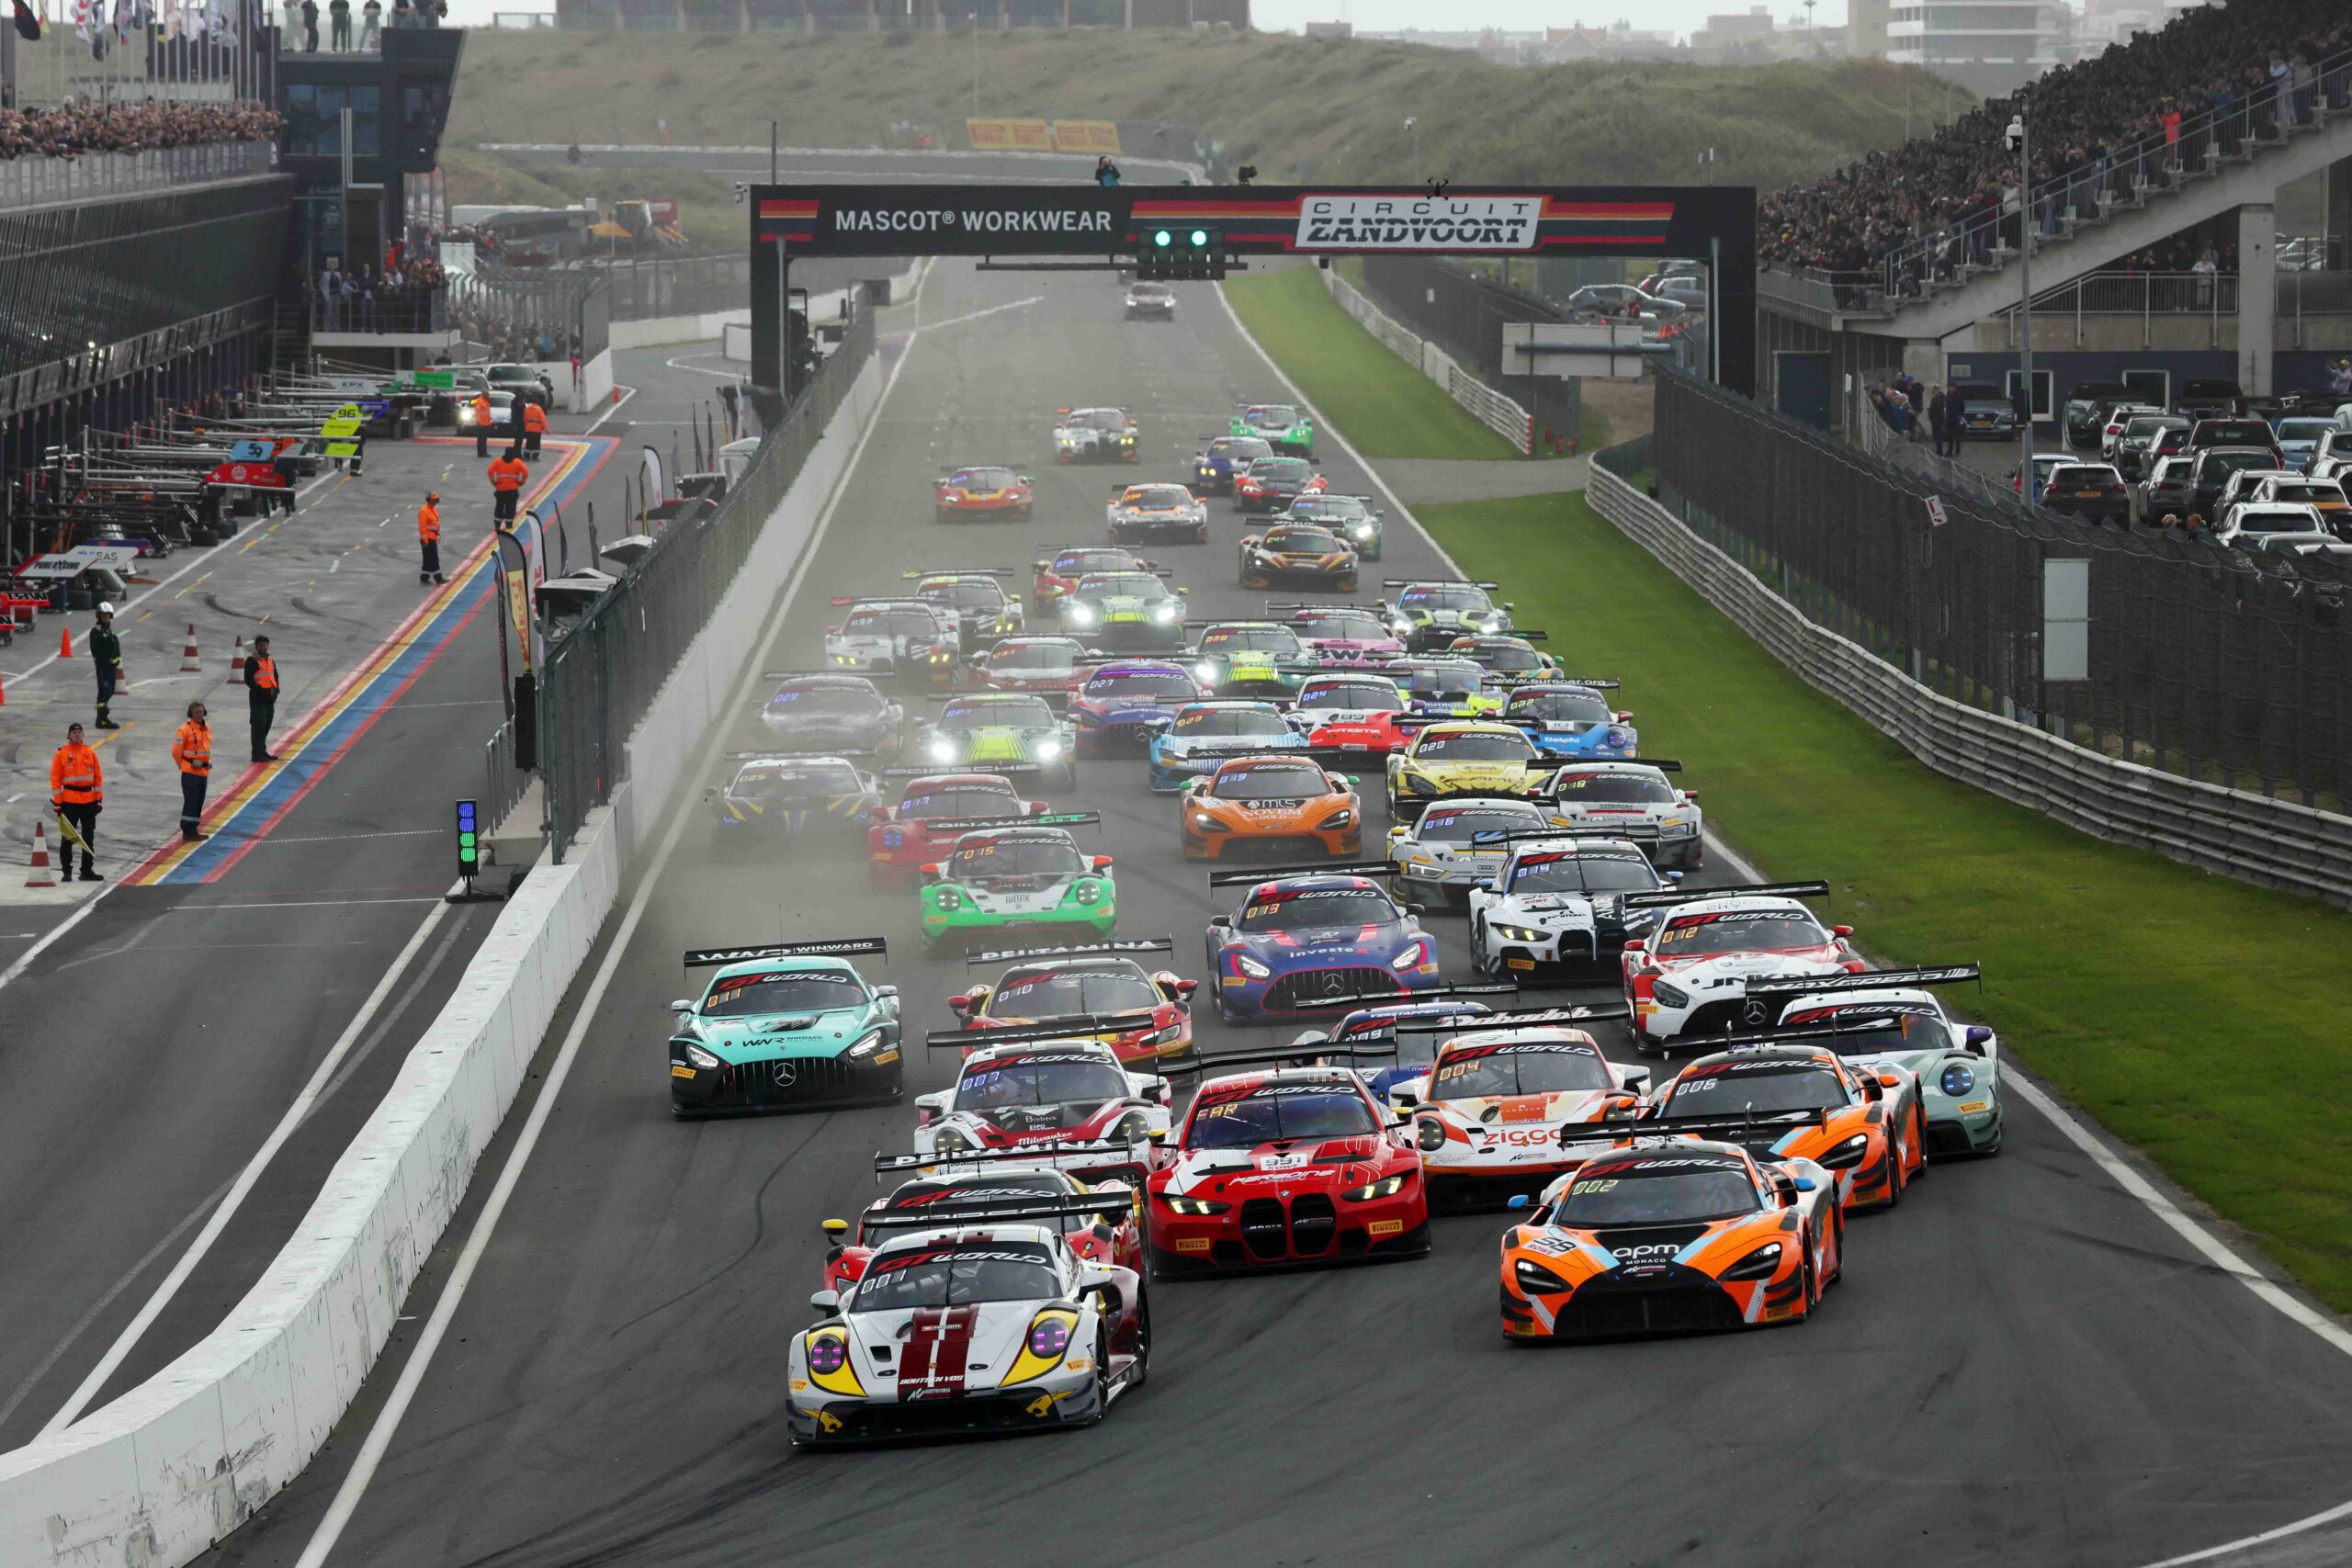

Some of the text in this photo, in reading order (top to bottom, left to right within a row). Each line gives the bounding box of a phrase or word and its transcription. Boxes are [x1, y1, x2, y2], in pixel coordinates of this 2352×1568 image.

[1313, 202, 1530, 215] CIRCUIT
[962, 210, 1113, 231] WORKWEAR
[1306, 218, 1528, 243] ZANDVOORT
[337, 409, 356, 418] 96
[1544, 736, 1580, 744] Delphi
[1419, 740, 1446, 754] 020
[1242, 809, 1303, 819] NOVEM
[1459, 808, 1533, 819] WORLD
[1561, 852, 1642, 862] WORLD
[1297, 891, 1378, 899] WORLD
[1672, 911, 1804, 927] GT WORLD
[1662, 926, 1699, 944] 012
[797, 942, 873, 953] WINWARD
[718, 973, 848, 989] GT WORLD
[1053, 972, 1138, 981] WORLD
[998, 984, 1033, 1002] 010
[1837, 1005, 1938, 1016] WORLD
[877, 1053, 899, 1063] PIRELLI
[1443, 1043, 1596, 1063] GT WORLD
[968, 1055, 1113, 1073] GT WORLD
[1730, 1060, 1834, 1071] WORLD
[673, 1068, 694, 1077] PIRELLI
[1439, 1060, 1481, 1082] 004
[961, 1071, 1001, 1092] 007
[1201, 1086, 1356, 1105] GT WORLD
[1196, 1103, 1238, 1122] FAR
[1961, 1102, 1986, 1112] PIRELLI
[1025, 1114, 1057, 1123] Brebeck
[1014, 1131, 1075, 1145] Milwaukee
[1265, 1156, 1303, 1167] 991
[1633, 1158, 1747, 1170] WORLD
[1572, 1179, 1619, 1196] 002
[896, 1188, 1057, 1209] GT WORLD
[1372, 1222, 1400, 1233] PIRELLI
[1179, 1240, 1207, 1249] PIRELLI
[1527, 1244, 1555, 1256] ROWE
[1533, 1236, 1576, 1252] 58
[1611, 1244, 1680, 1259] apm
[874, 1250, 1047, 1273] GT WORLD
